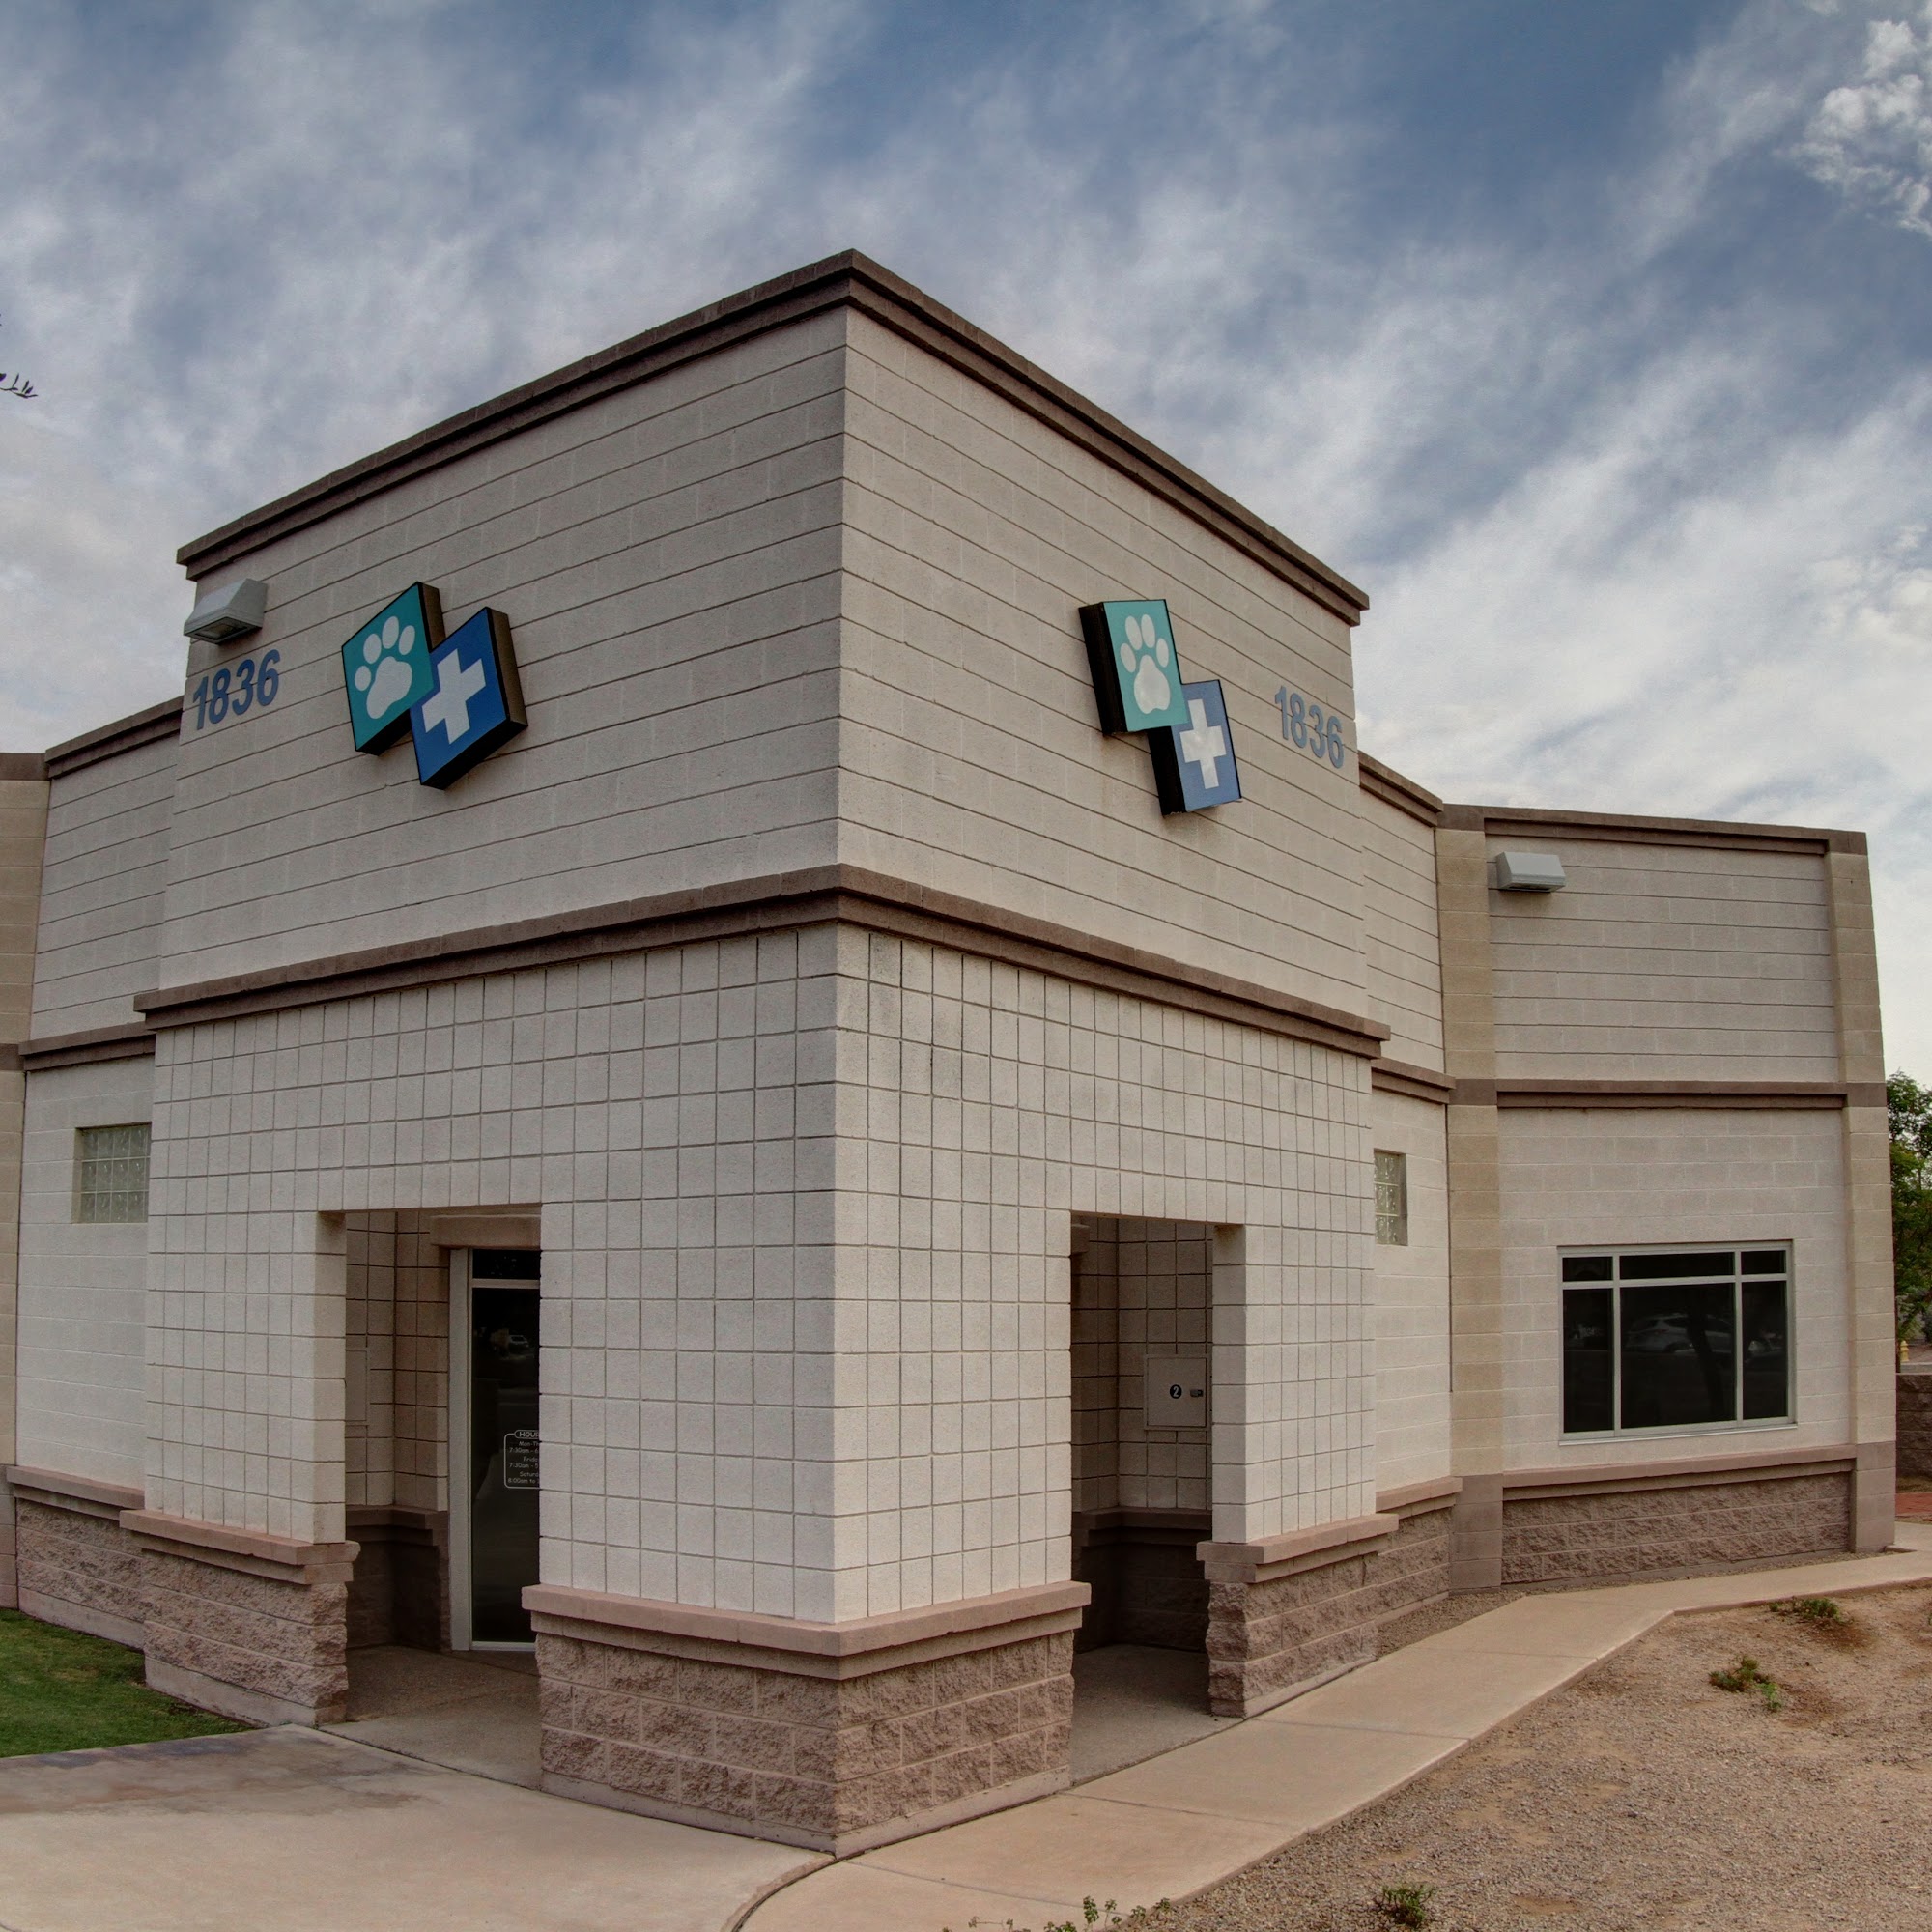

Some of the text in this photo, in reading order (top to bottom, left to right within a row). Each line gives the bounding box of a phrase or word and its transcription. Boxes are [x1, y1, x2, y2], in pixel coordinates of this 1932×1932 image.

[193, 648, 281, 730] 1836
[1274, 685, 1345, 769] 1836
[1172, 1385, 1179, 1397] 2
